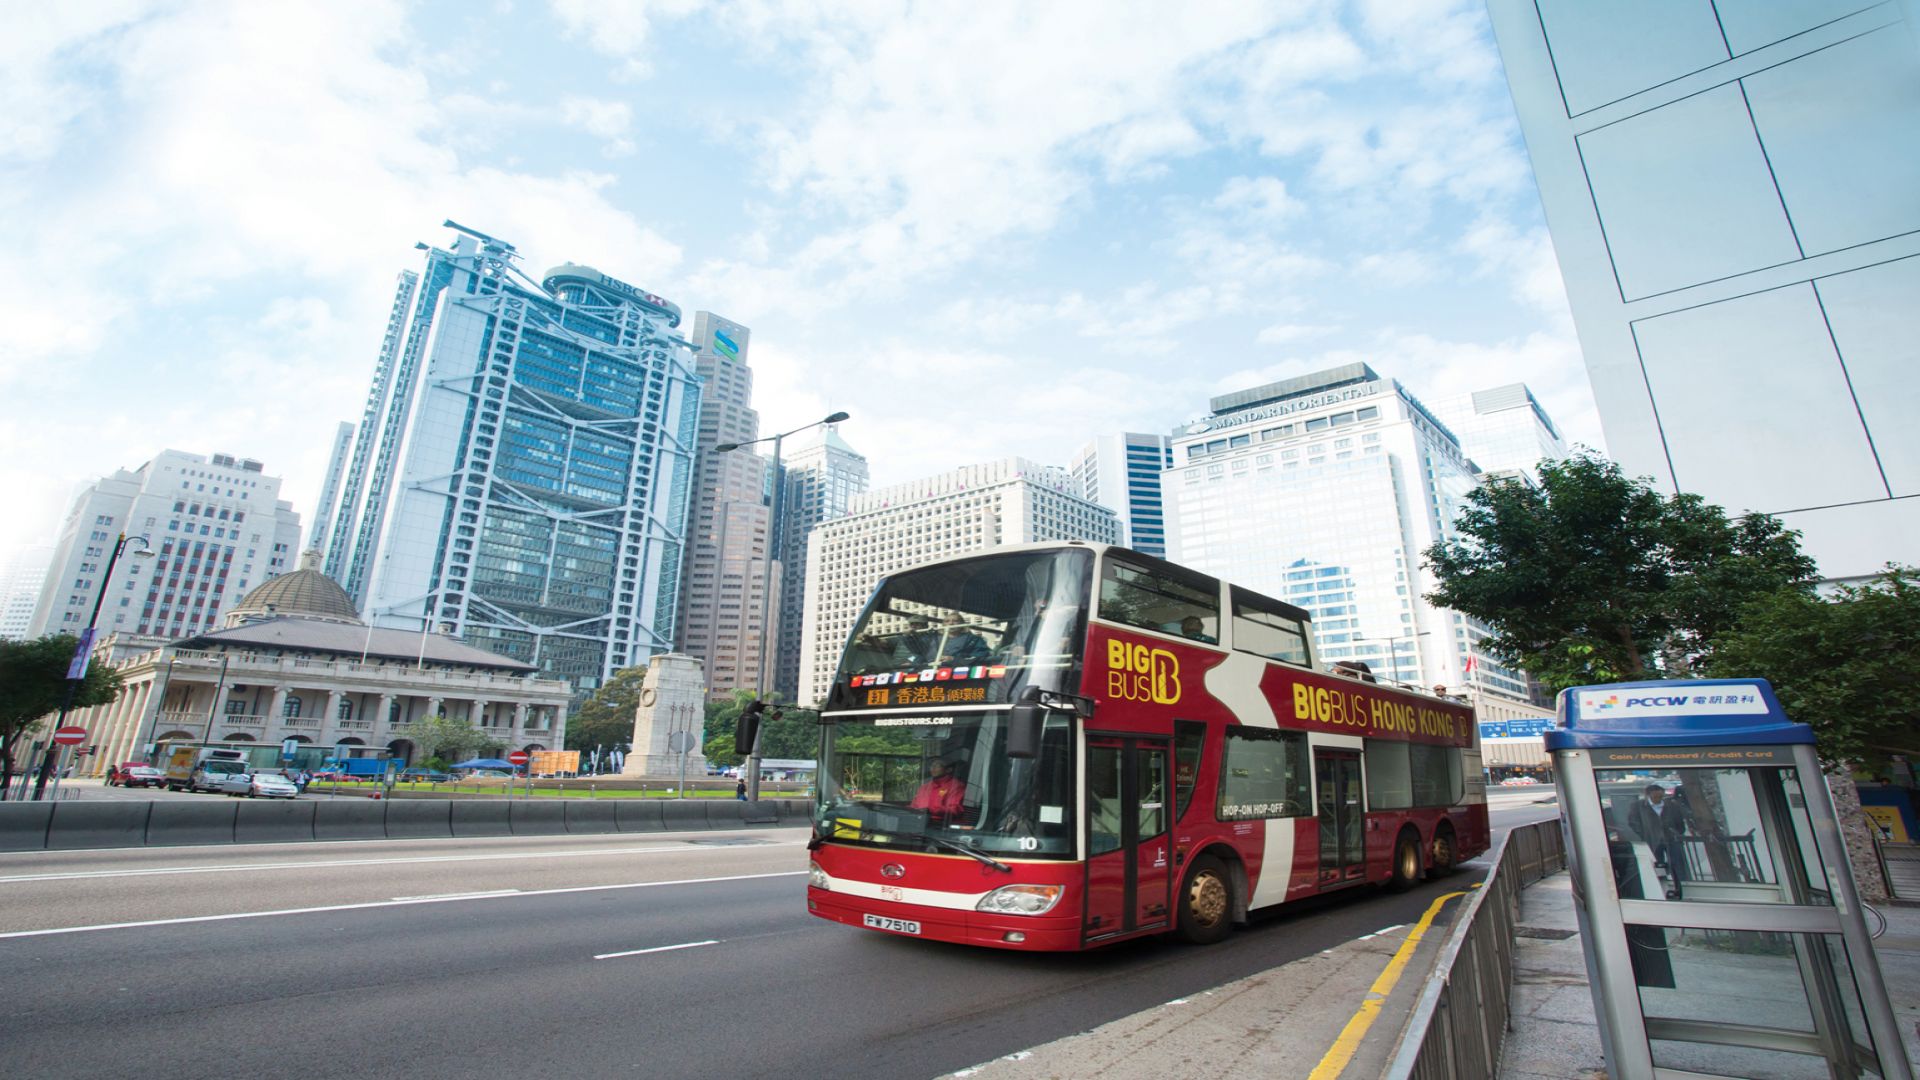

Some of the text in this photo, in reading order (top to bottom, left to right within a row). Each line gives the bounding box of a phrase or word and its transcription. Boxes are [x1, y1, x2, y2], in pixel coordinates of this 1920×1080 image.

[601, 275, 644, 298] HSBC
[1215, 385, 1378, 430] MANDARIN ORIENTAL
[1108, 639, 1150, 673] BIG
[1109, 671, 1151, 702] BUS
[1626, 696, 1688, 708] PCCW
[1693, 695, 1755, 705] 電訊盈科
[1371, 698, 1416, 733] HONG
[1419, 708, 1454, 738] KONG
[1609, 753, 1634, 761] Coin
[1640, 752, 1699, 760] Phonecard
[1707, 751, 1742, 759] Credit
[1222, 803, 1284, 816] HOP-ON HOP-OFF
[1017, 837, 1037, 850] 10
